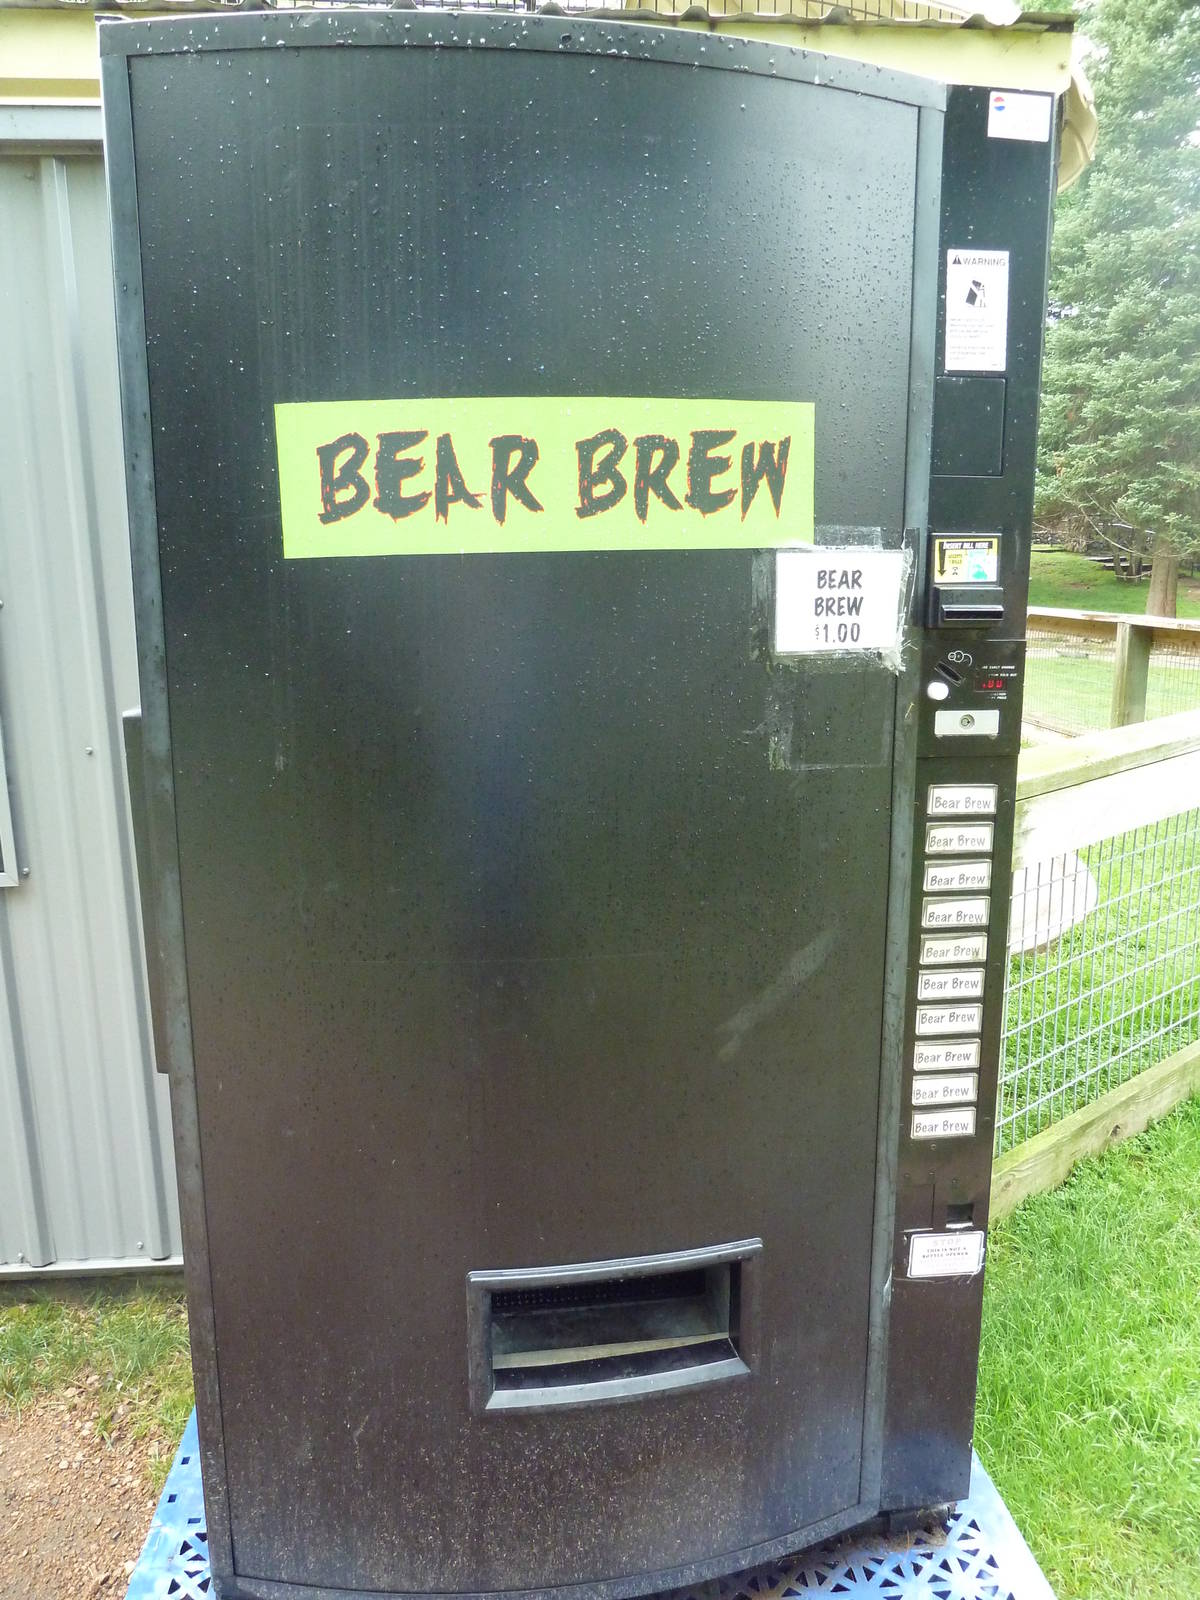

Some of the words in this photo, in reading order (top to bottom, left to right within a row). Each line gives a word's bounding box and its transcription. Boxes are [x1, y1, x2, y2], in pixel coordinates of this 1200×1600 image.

[962, 257, 1006, 267] WARNING
[316, 429, 545, 526] BEAR
[574, 427, 792, 524] BREW
[817, 569, 863, 590] BEAR
[814, 596, 864, 617] BREW
[814, 622, 861, 643] $1.00
[934, 796, 960, 809] Bear
[964, 796, 991, 809] Brew
[929, 836, 954, 848] Bear
[957, 834, 985, 846] Brew
[930, 875, 955, 887] Bear
[958, 873, 985, 885] Brew
[927, 911, 952, 923] Bear
[956, 910, 983, 922] Brew
[926, 947, 950, 958] Bear
[953, 945, 980, 956] Brew
[923, 978, 948, 990] Bear
[951, 977, 979, 989] Brew
[920, 1012, 945, 1024] Bear
[948, 1011, 976, 1023] Brew
[918, 1052, 941, 1064] Bear
[944, 1051, 971, 1062] Brew
[915, 1088, 939, 1100] Bear
[942, 1086, 969, 1097] Brew
[915, 1122, 939, 1133] Bear
[942, 1120, 969, 1132] Brew
